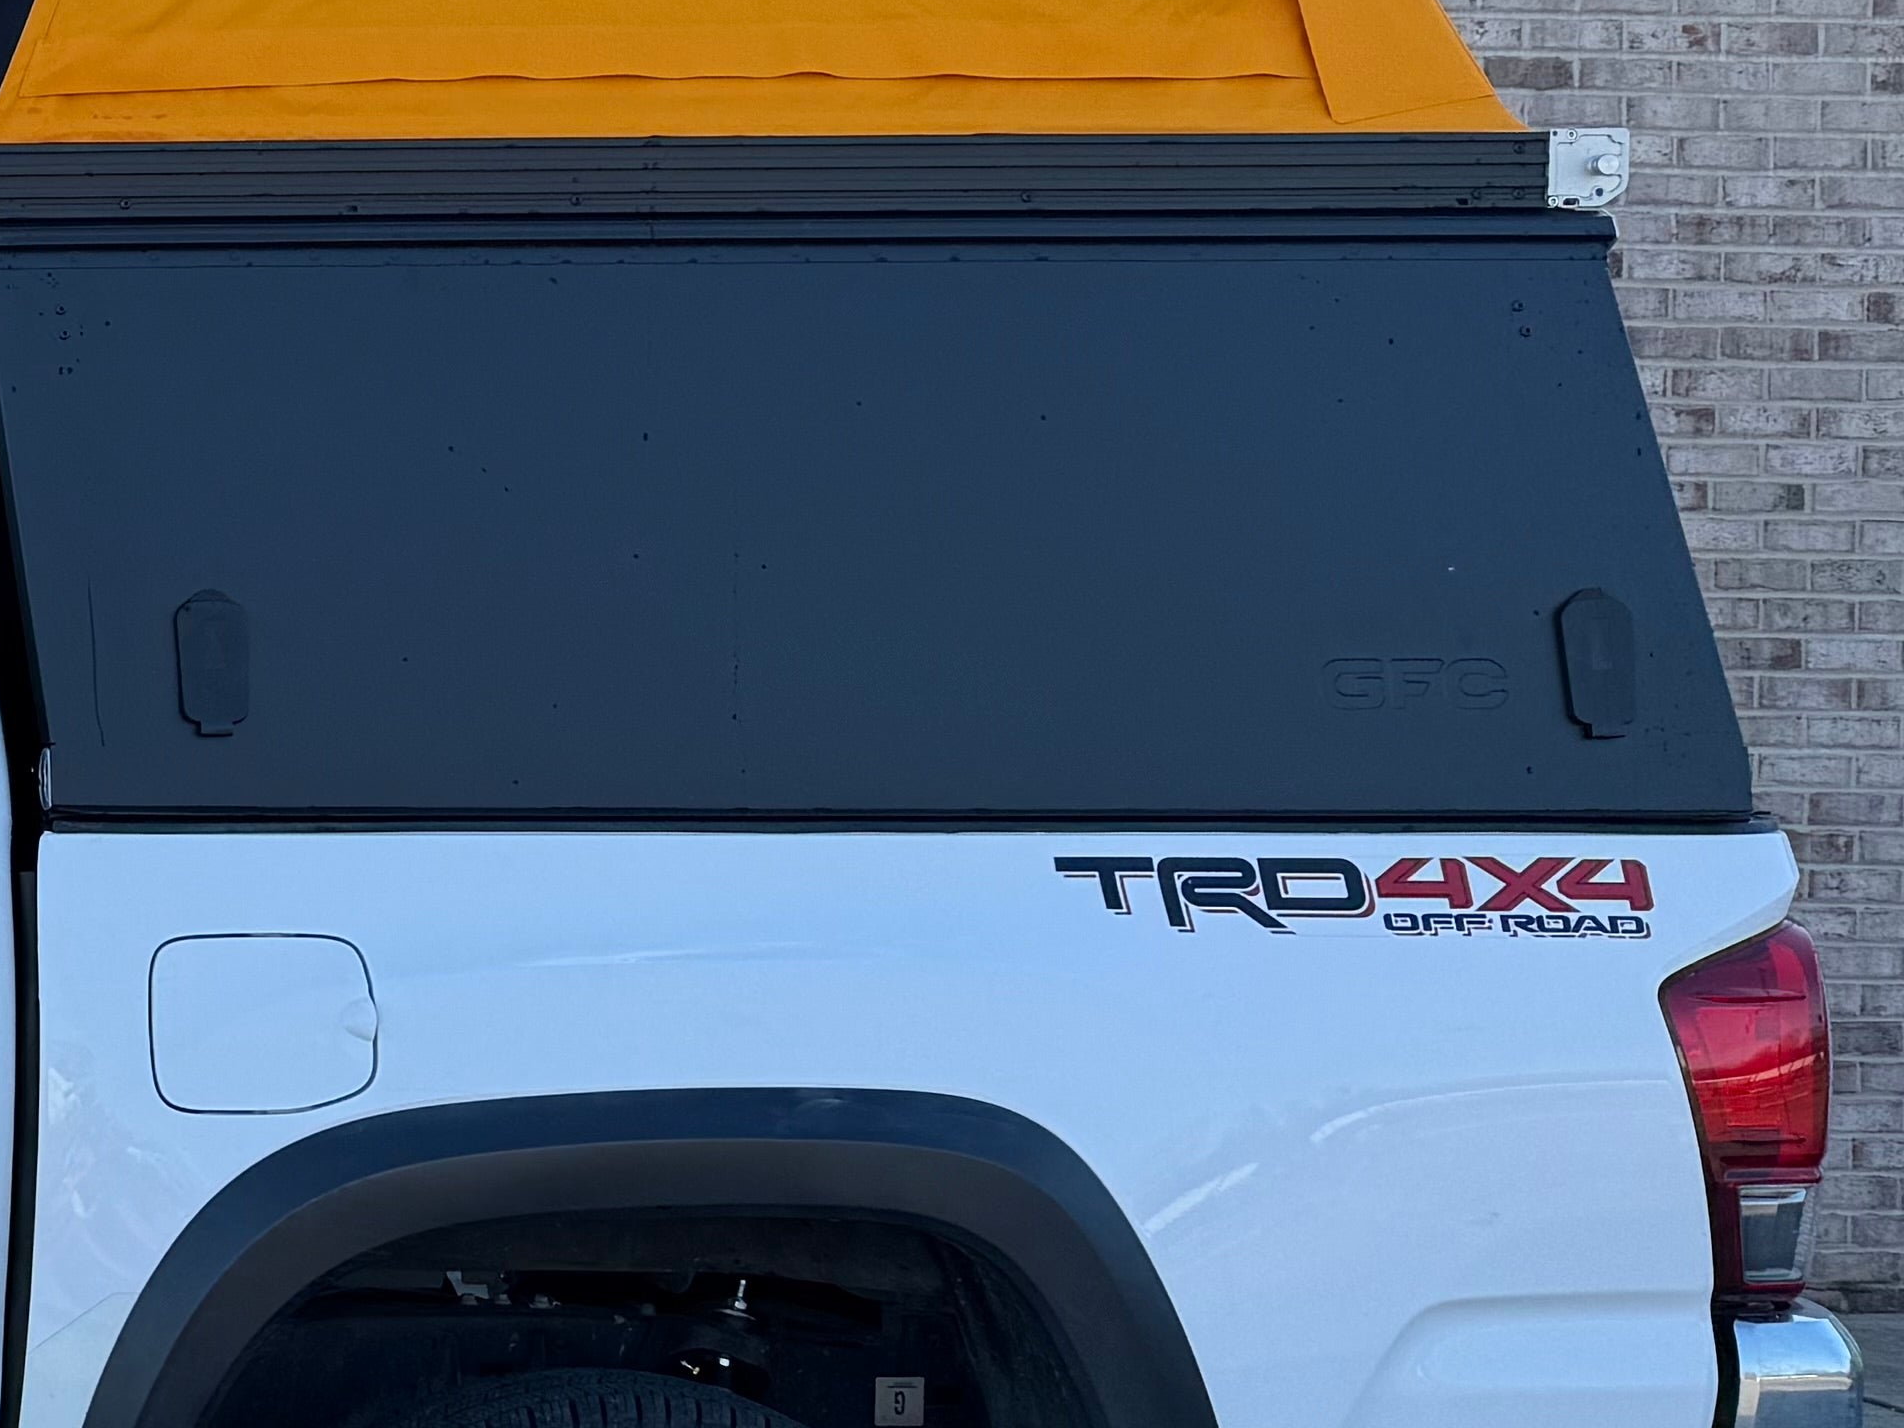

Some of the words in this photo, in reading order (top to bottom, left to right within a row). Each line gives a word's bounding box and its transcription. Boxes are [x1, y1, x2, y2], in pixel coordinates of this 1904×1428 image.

[1322, 658, 1509, 710] GFC
[1053, 856, 1375, 935] TRD
[1384, 912, 1493, 937] OFF
[1499, 914, 1651, 939] ROAD
